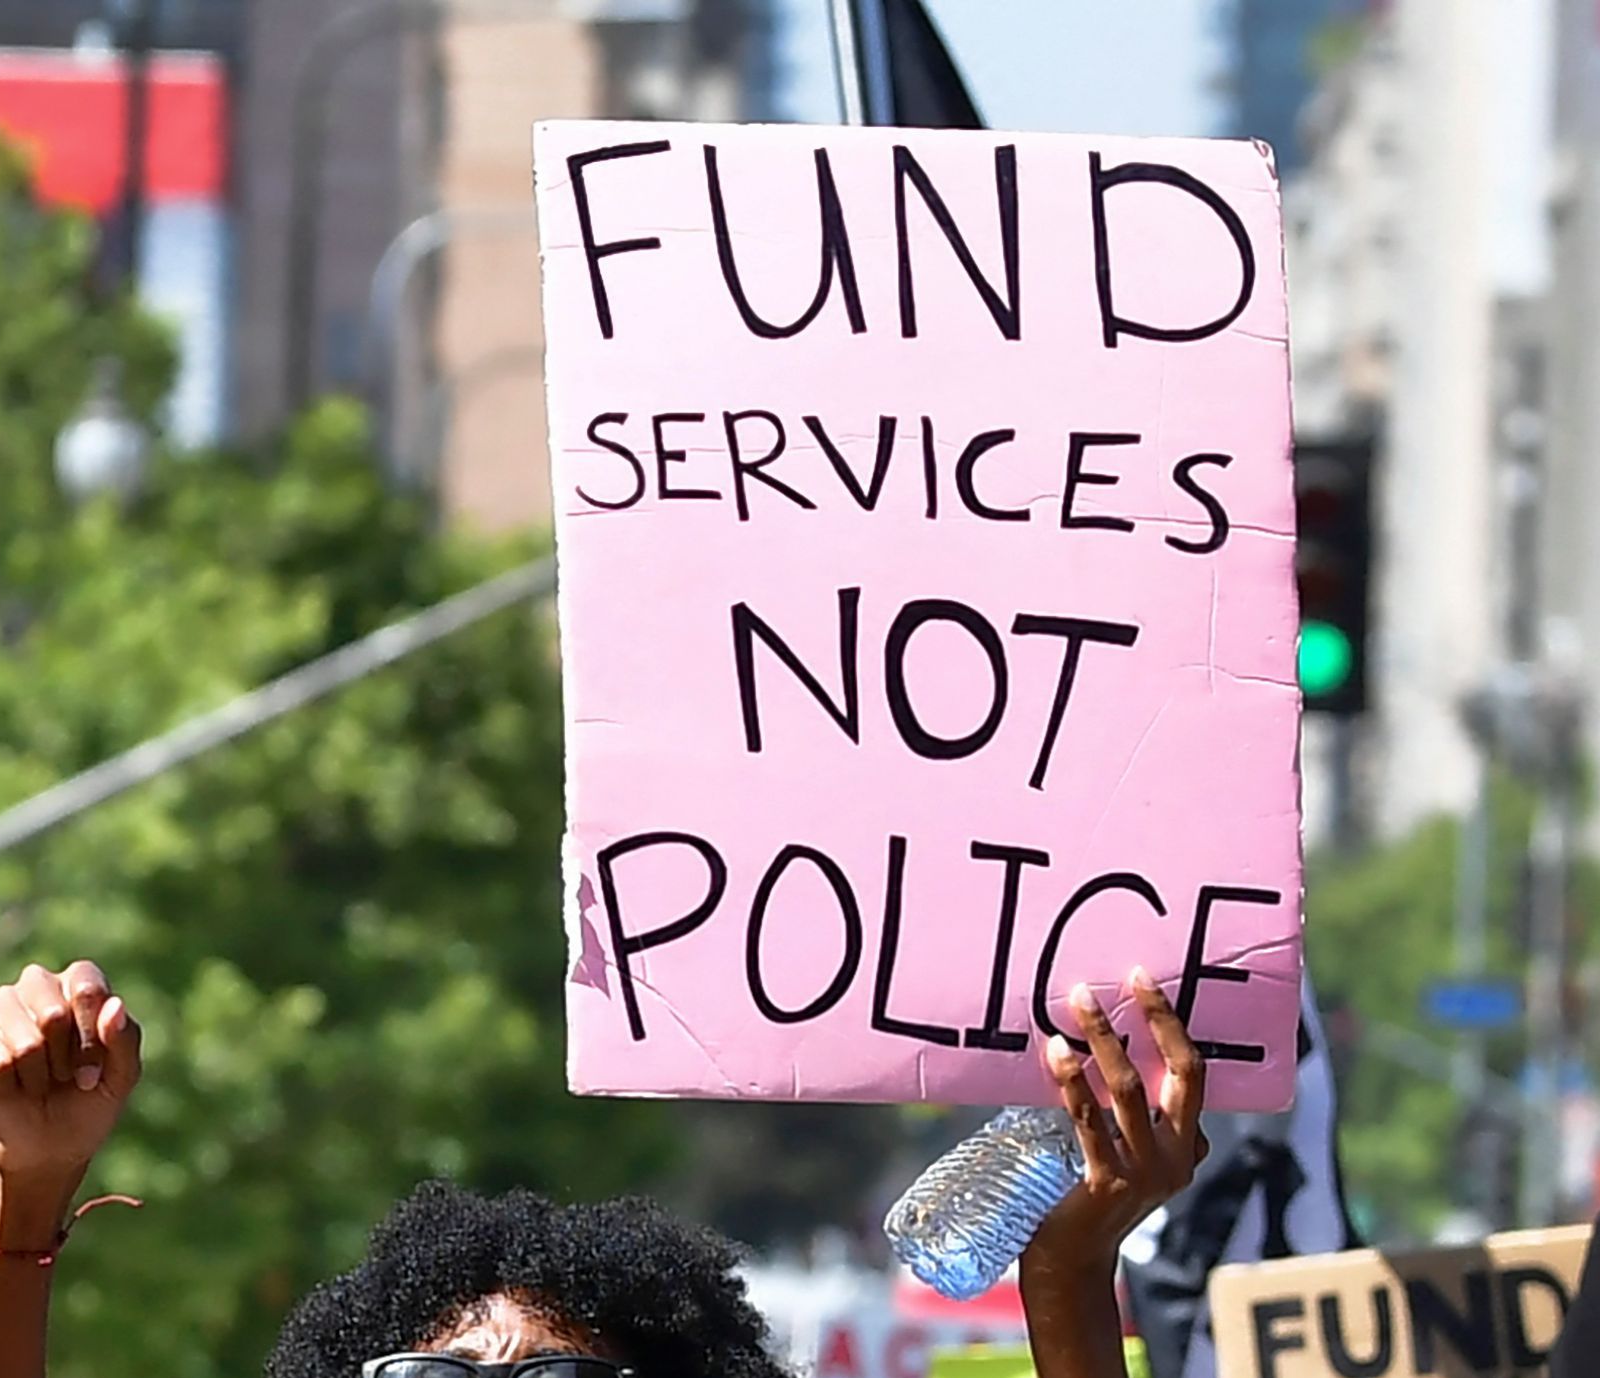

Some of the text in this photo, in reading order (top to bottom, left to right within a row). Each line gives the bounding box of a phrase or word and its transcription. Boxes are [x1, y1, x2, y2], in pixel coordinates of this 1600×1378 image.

[566, 140, 1256, 349] FUND
[576, 410, 1234, 554] SERVICES
[730, 586, 1141, 791] NOT
[597, 829, 1281, 1062] POLICE
